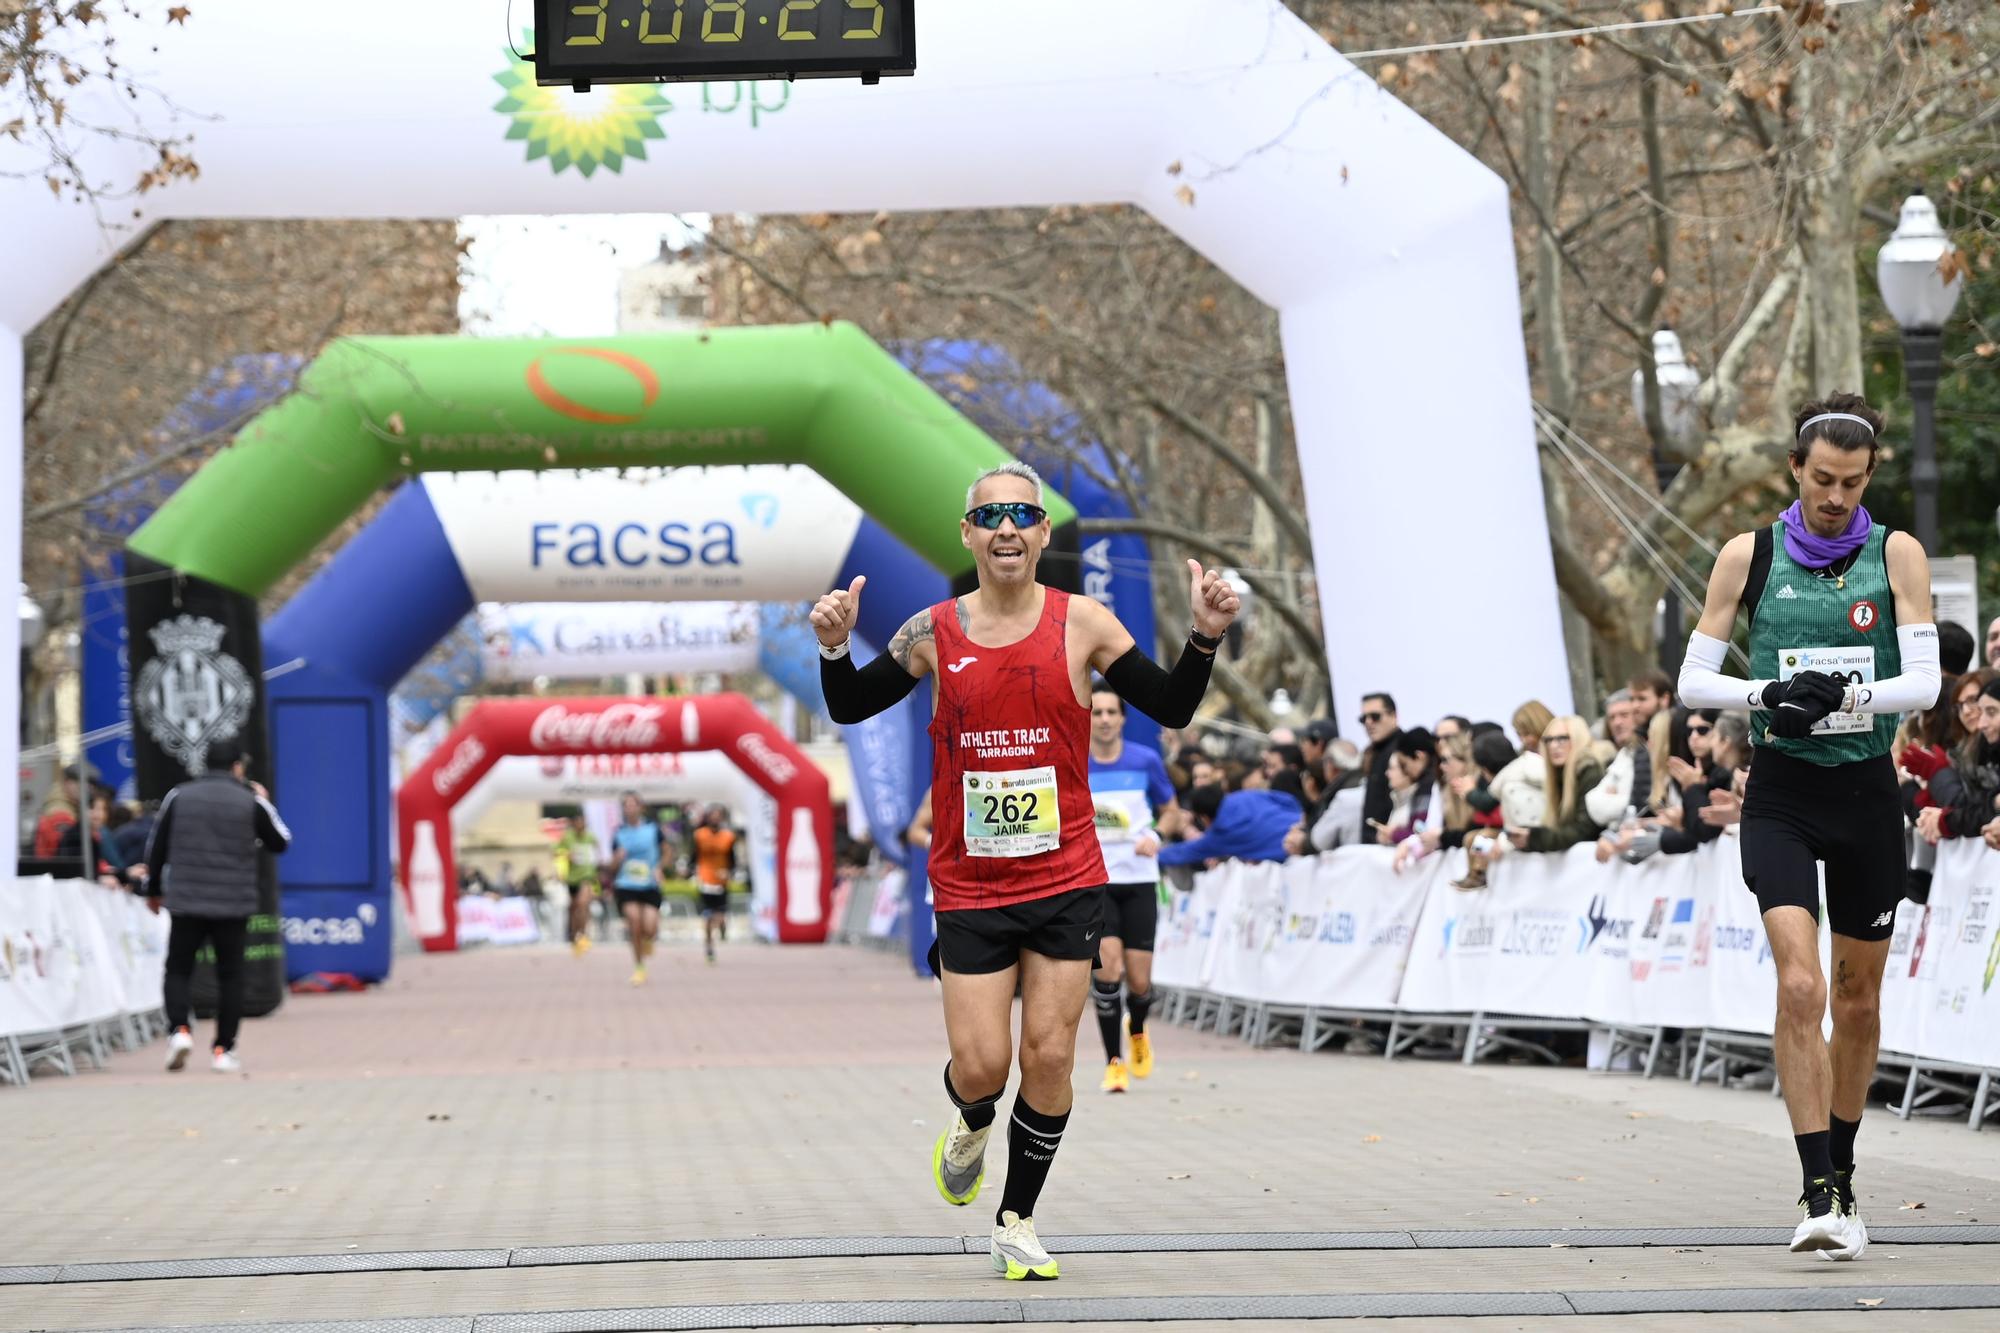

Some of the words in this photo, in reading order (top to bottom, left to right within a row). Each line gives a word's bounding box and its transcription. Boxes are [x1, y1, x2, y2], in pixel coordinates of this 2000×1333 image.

[960, 730, 1009, 748] ATHLETIC
[1013, 727, 1050, 745] TRACK
[976, 746, 1036, 758] TARRAGONA
[983, 792, 1039, 825] 262
[994, 823, 1030, 836] JAIME
